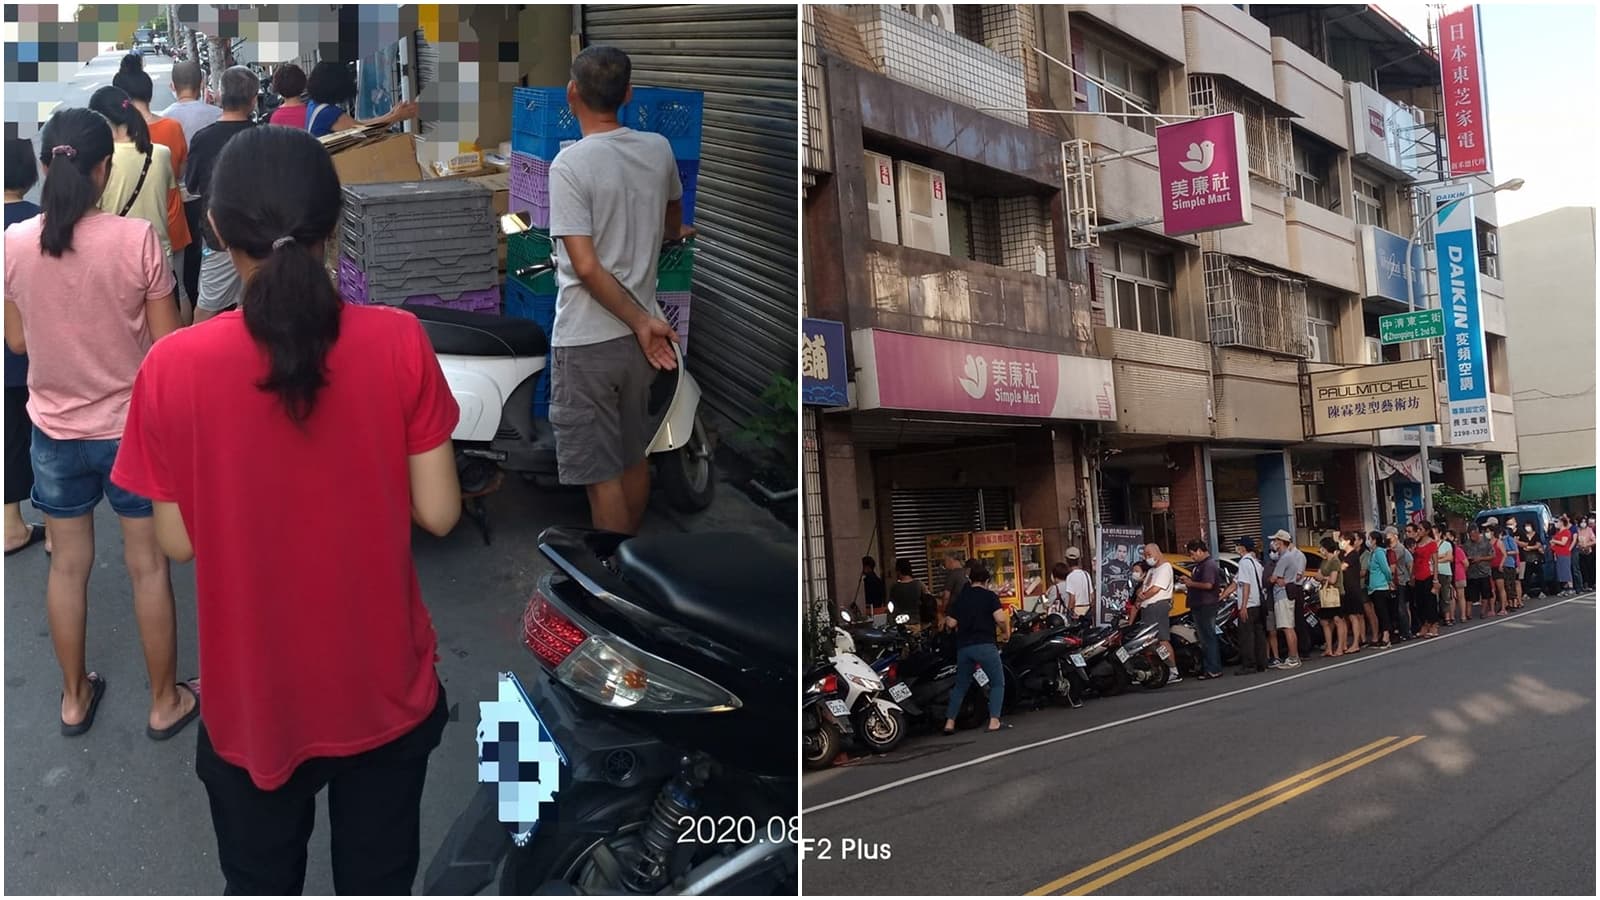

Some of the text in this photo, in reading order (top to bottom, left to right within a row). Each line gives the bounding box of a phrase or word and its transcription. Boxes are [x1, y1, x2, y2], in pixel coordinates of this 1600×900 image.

[1450, 22, 1476, 149] 日本東芝家電
[1170, 171, 1231, 200] 美廉社
[1436, 191, 1466, 201] DAIKIN
[1172, 191, 1232, 210] Simple Mart
[1448, 245, 1469, 329] DAIKIN
[991, 359, 1040, 389] 美廉社
[995, 388, 1041, 406] Simple Mart
